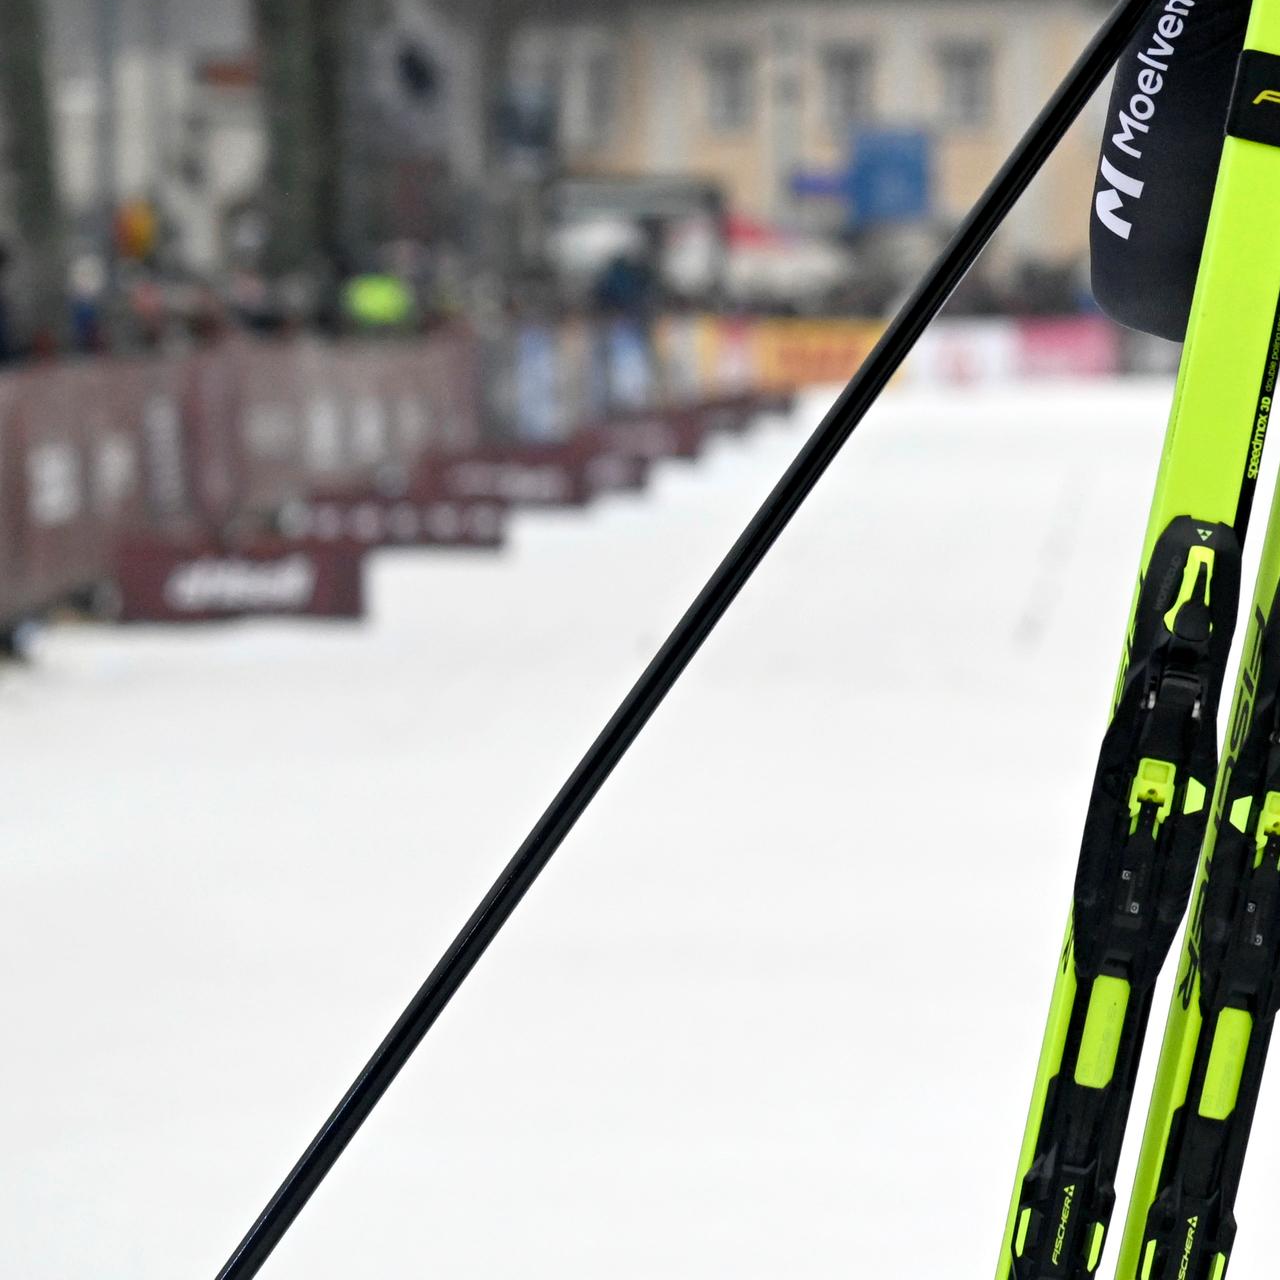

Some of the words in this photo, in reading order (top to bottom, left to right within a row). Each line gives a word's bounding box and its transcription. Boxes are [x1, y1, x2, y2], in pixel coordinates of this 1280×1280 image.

[1247, 414, 1269, 480] speedmax
[1260, 396, 1272, 412] 3D
[1051, 1196, 1072, 1266] FISCHER
[1177, 1227, 1196, 1280] SCHER
